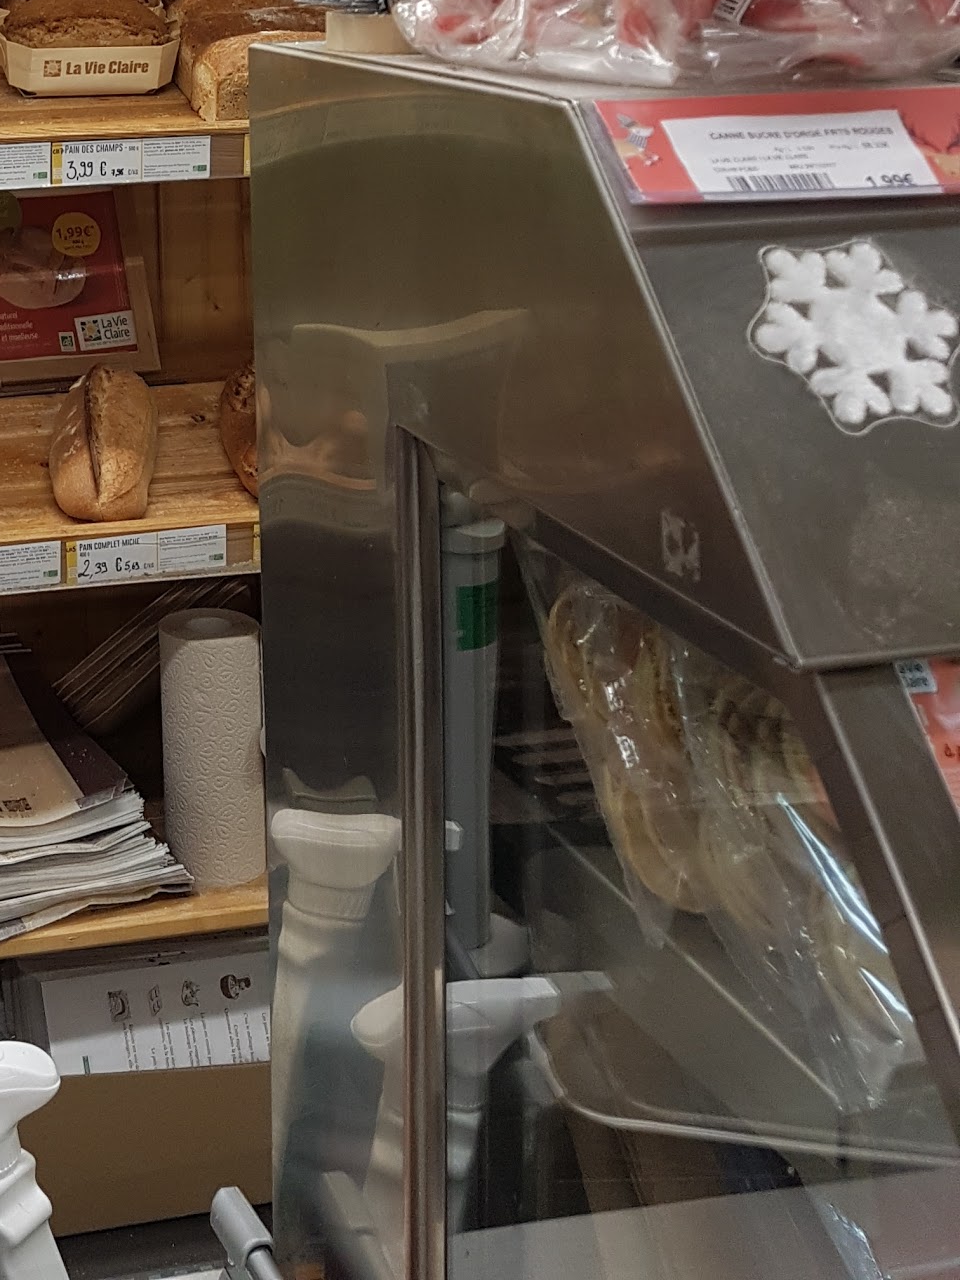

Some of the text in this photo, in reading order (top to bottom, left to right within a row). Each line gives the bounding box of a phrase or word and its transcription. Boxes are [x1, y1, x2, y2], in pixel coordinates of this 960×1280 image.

[66, 60, 149, 75] La Vie Claire
[64, 143, 123, 154] PAIN DES CHAMPS
[66, 160, 93, 180] 3,99
[101, 315, 127, 329] La Vie
[104, 327, 130, 340] Claire
[79, 537, 140, 552] PAIN COMPLET MICHE
[77, 559, 108, 579] 2,39
